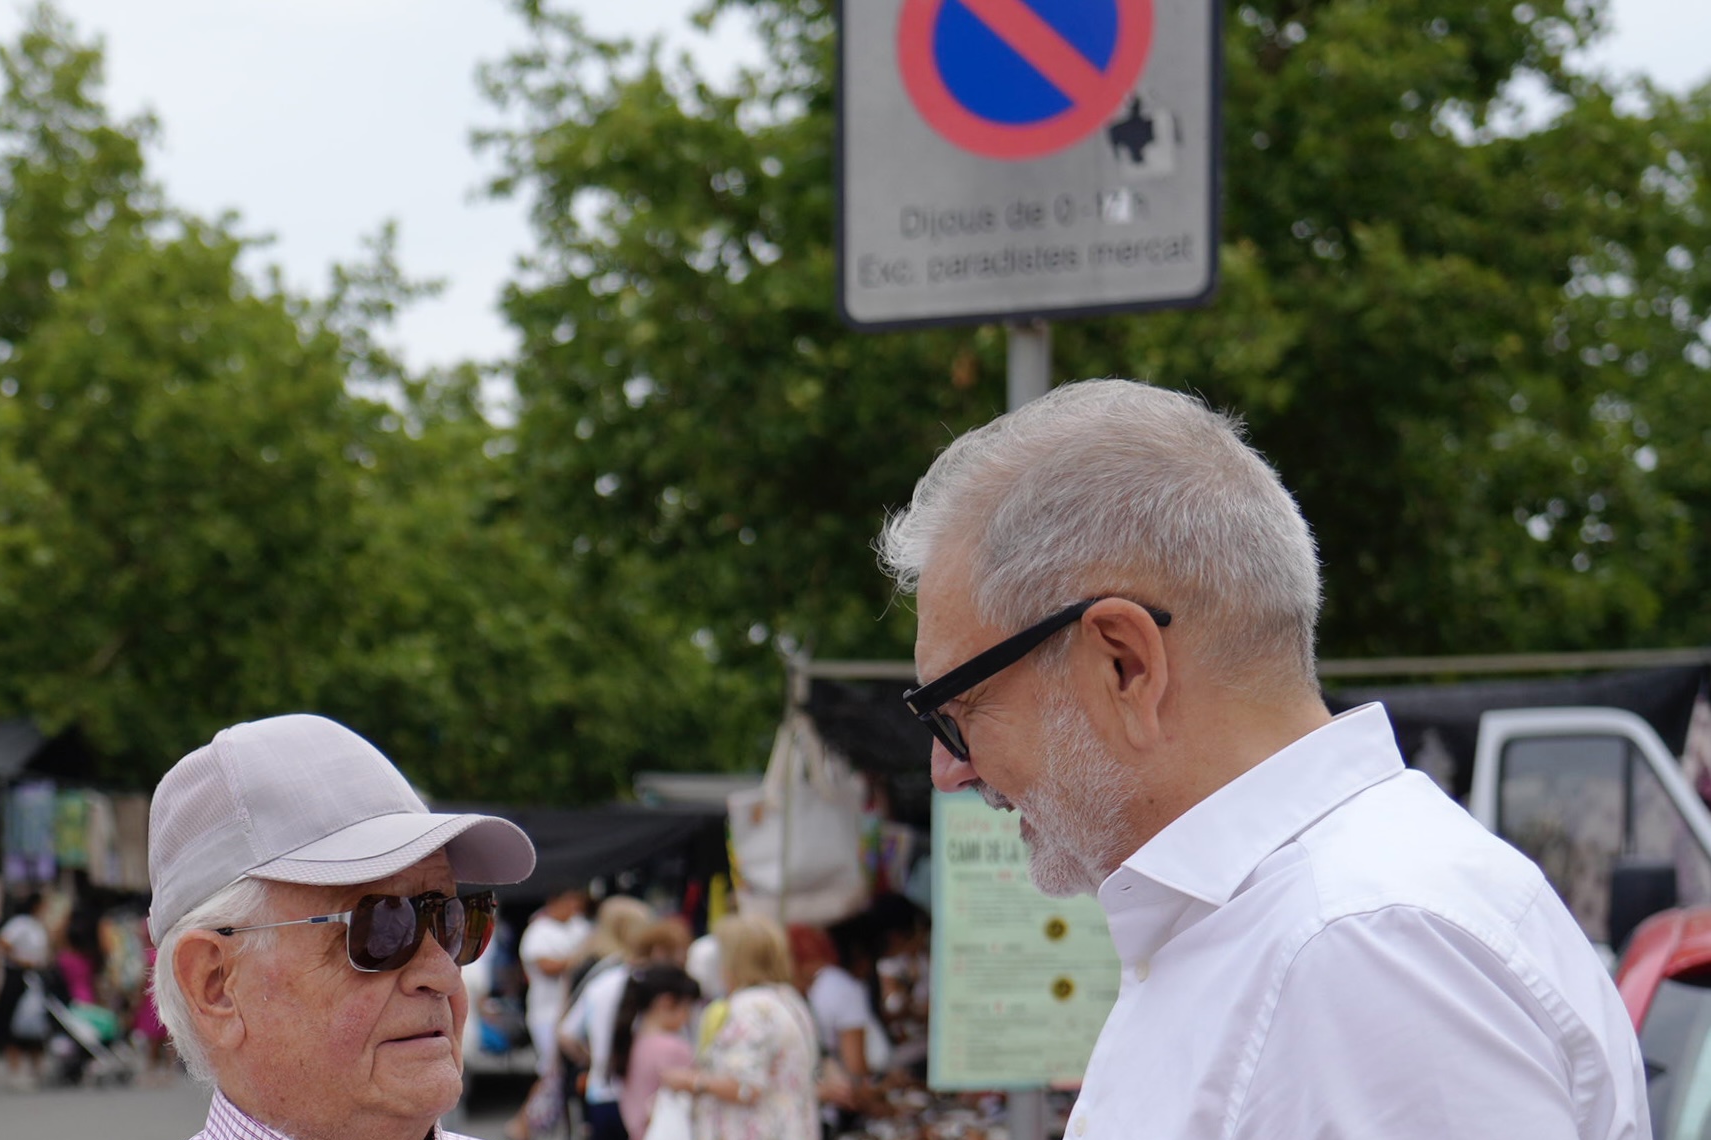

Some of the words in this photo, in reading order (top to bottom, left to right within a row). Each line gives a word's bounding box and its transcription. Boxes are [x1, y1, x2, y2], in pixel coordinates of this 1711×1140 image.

[899, 202, 997, 243] Dijous
[1004, 195, 1046, 231] de
[1087, 232, 1194, 269] mercat
